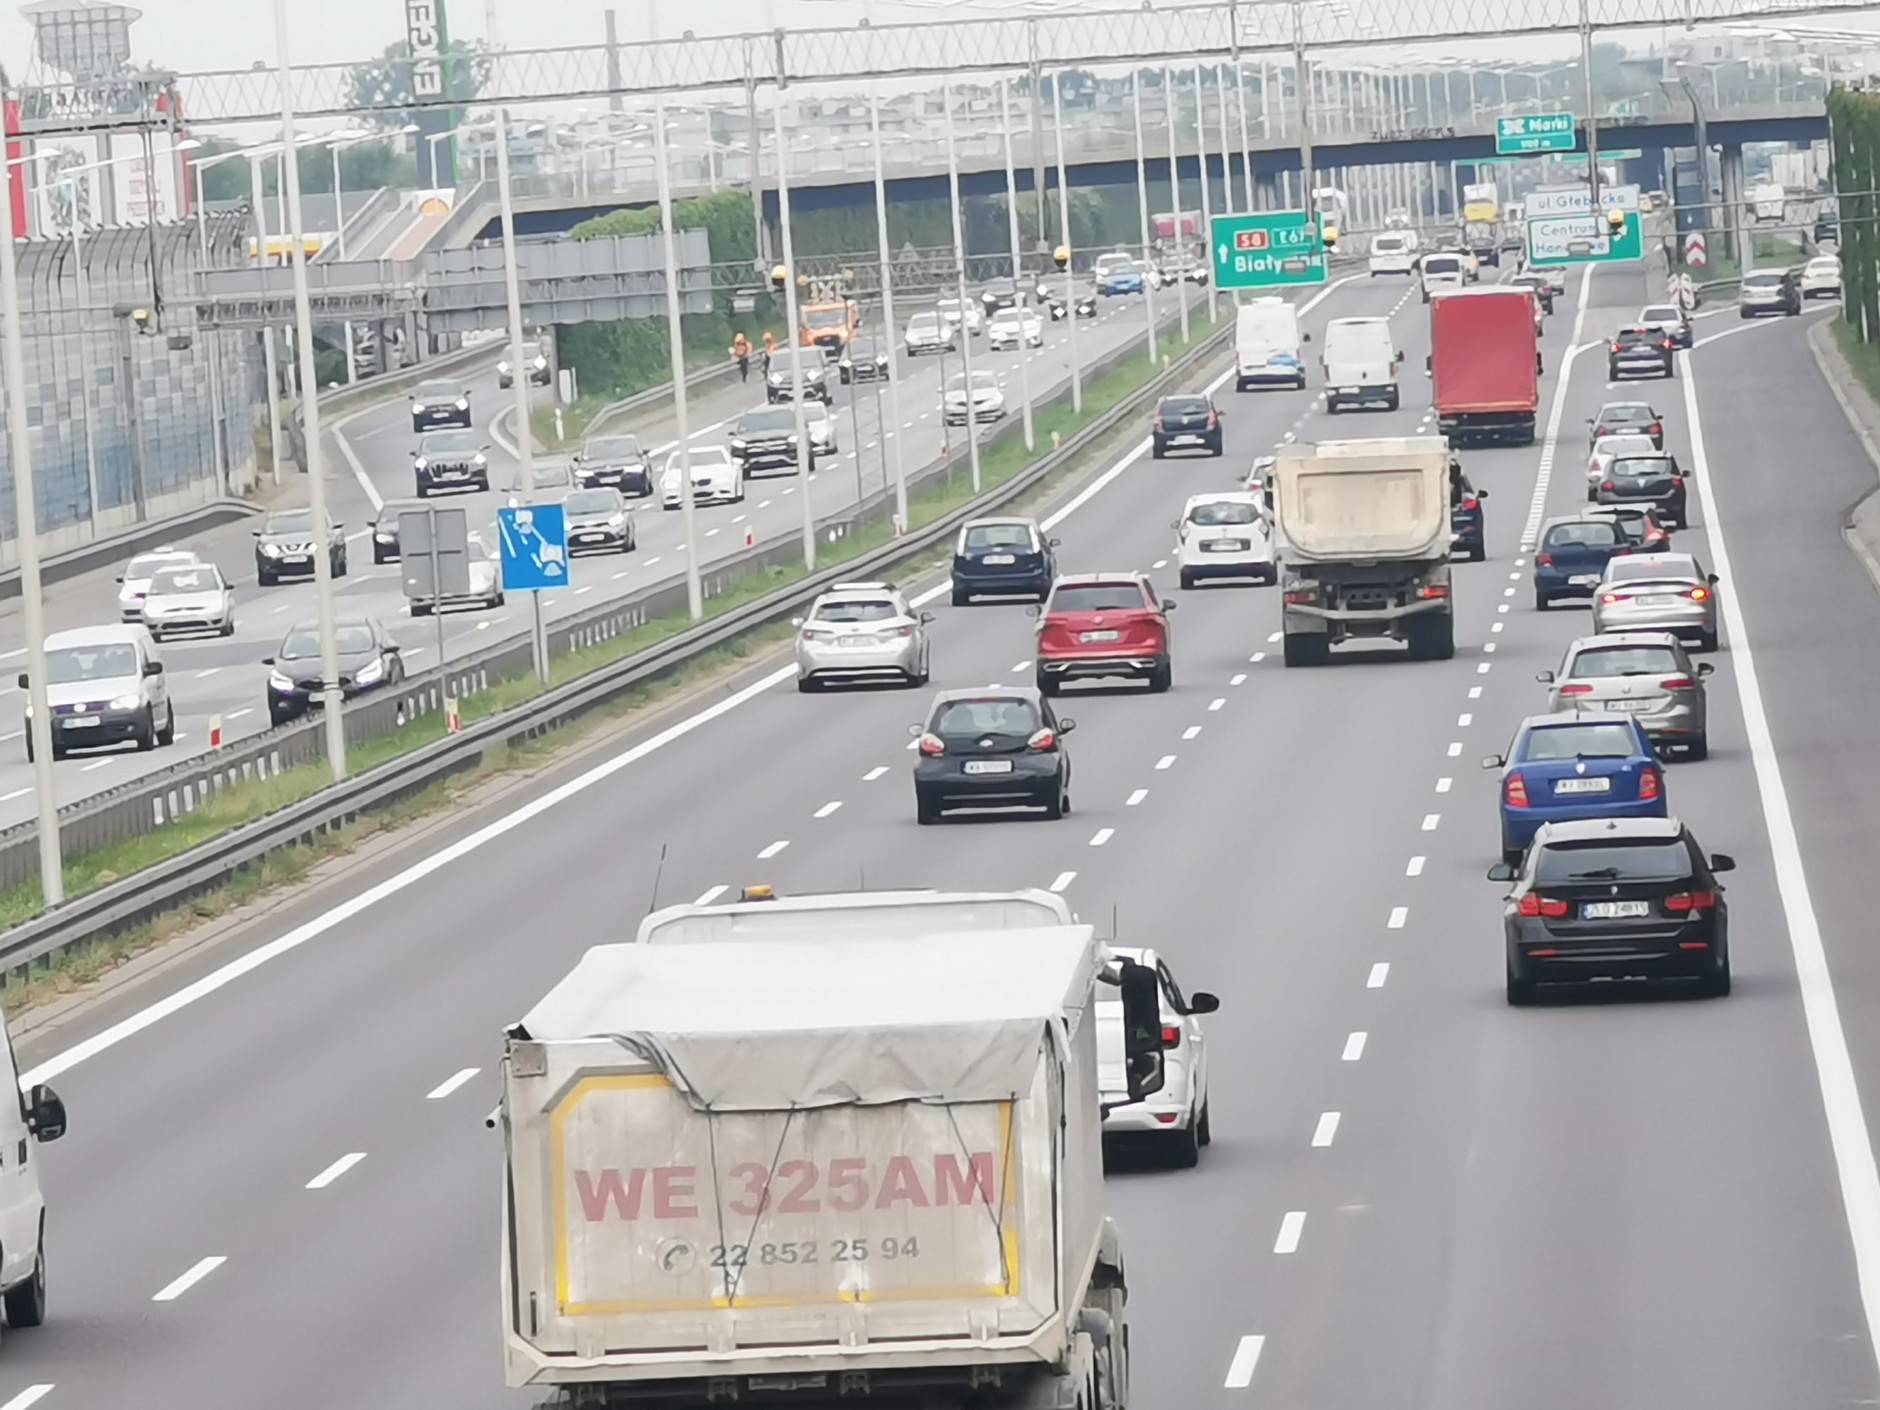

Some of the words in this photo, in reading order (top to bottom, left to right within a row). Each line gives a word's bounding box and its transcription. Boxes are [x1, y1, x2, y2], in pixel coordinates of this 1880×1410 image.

[574, 1166, 699, 1222] WE
[728, 1152, 995, 1217] 325AM
[710, 1245, 748, 1268] 22
[760, 1241, 820, 1265] 852
[831, 1239, 870, 1263] 25
[880, 1236, 920, 1260] 94
